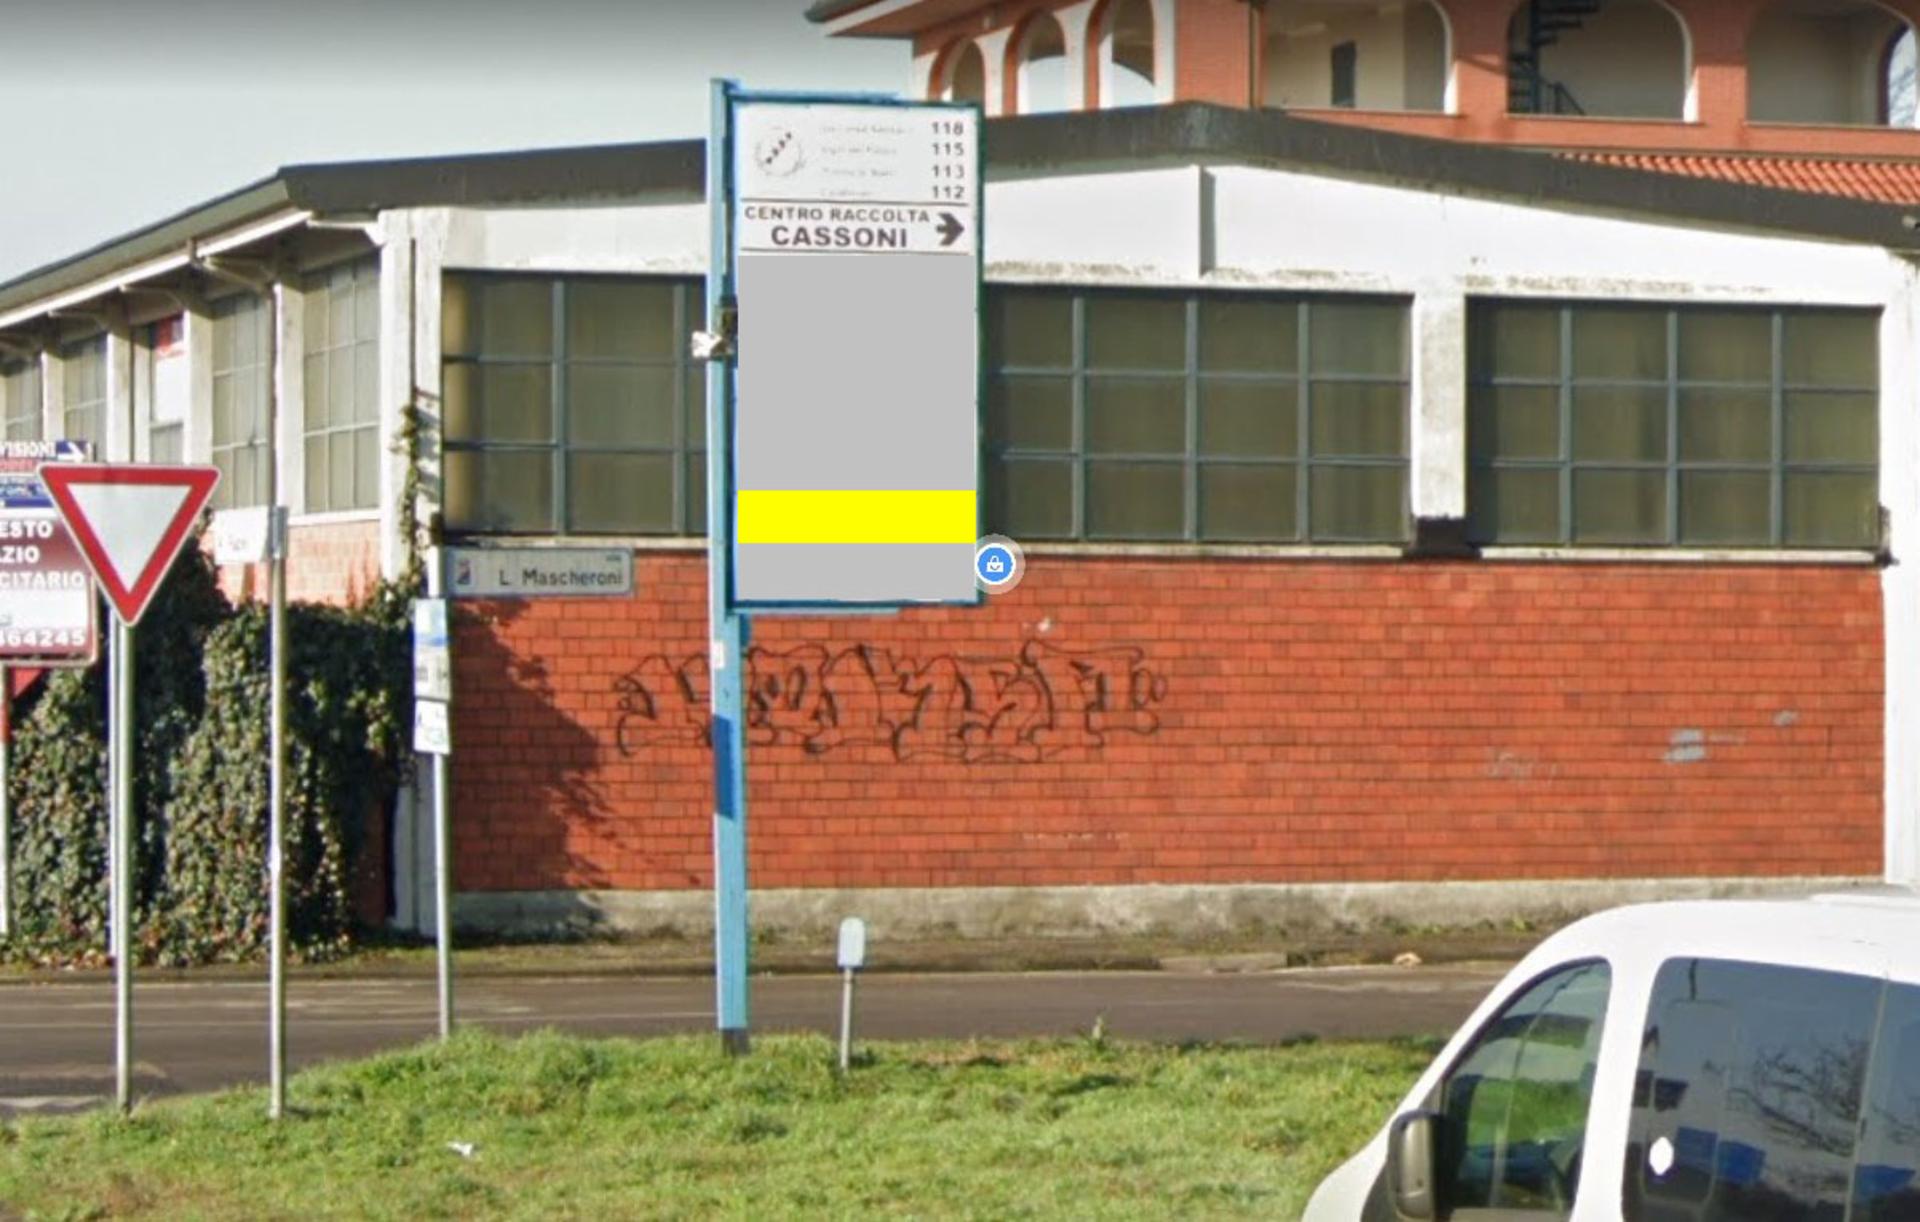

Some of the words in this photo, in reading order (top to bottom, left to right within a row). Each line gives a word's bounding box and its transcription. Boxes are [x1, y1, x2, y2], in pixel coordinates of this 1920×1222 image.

[931, 121, 964, 136] 118
[931, 143, 964, 157] 115
[931, 165, 964, 179] 113
[931, 186, 964, 200] 112
[744, 206, 823, 221] CENTRO
[830, 207, 930, 223] RACCOLTA
[770, 225, 908, 248] CASSONI
[499, 569, 511, 586] L
[522, 567, 625, 586] Mascheroni
